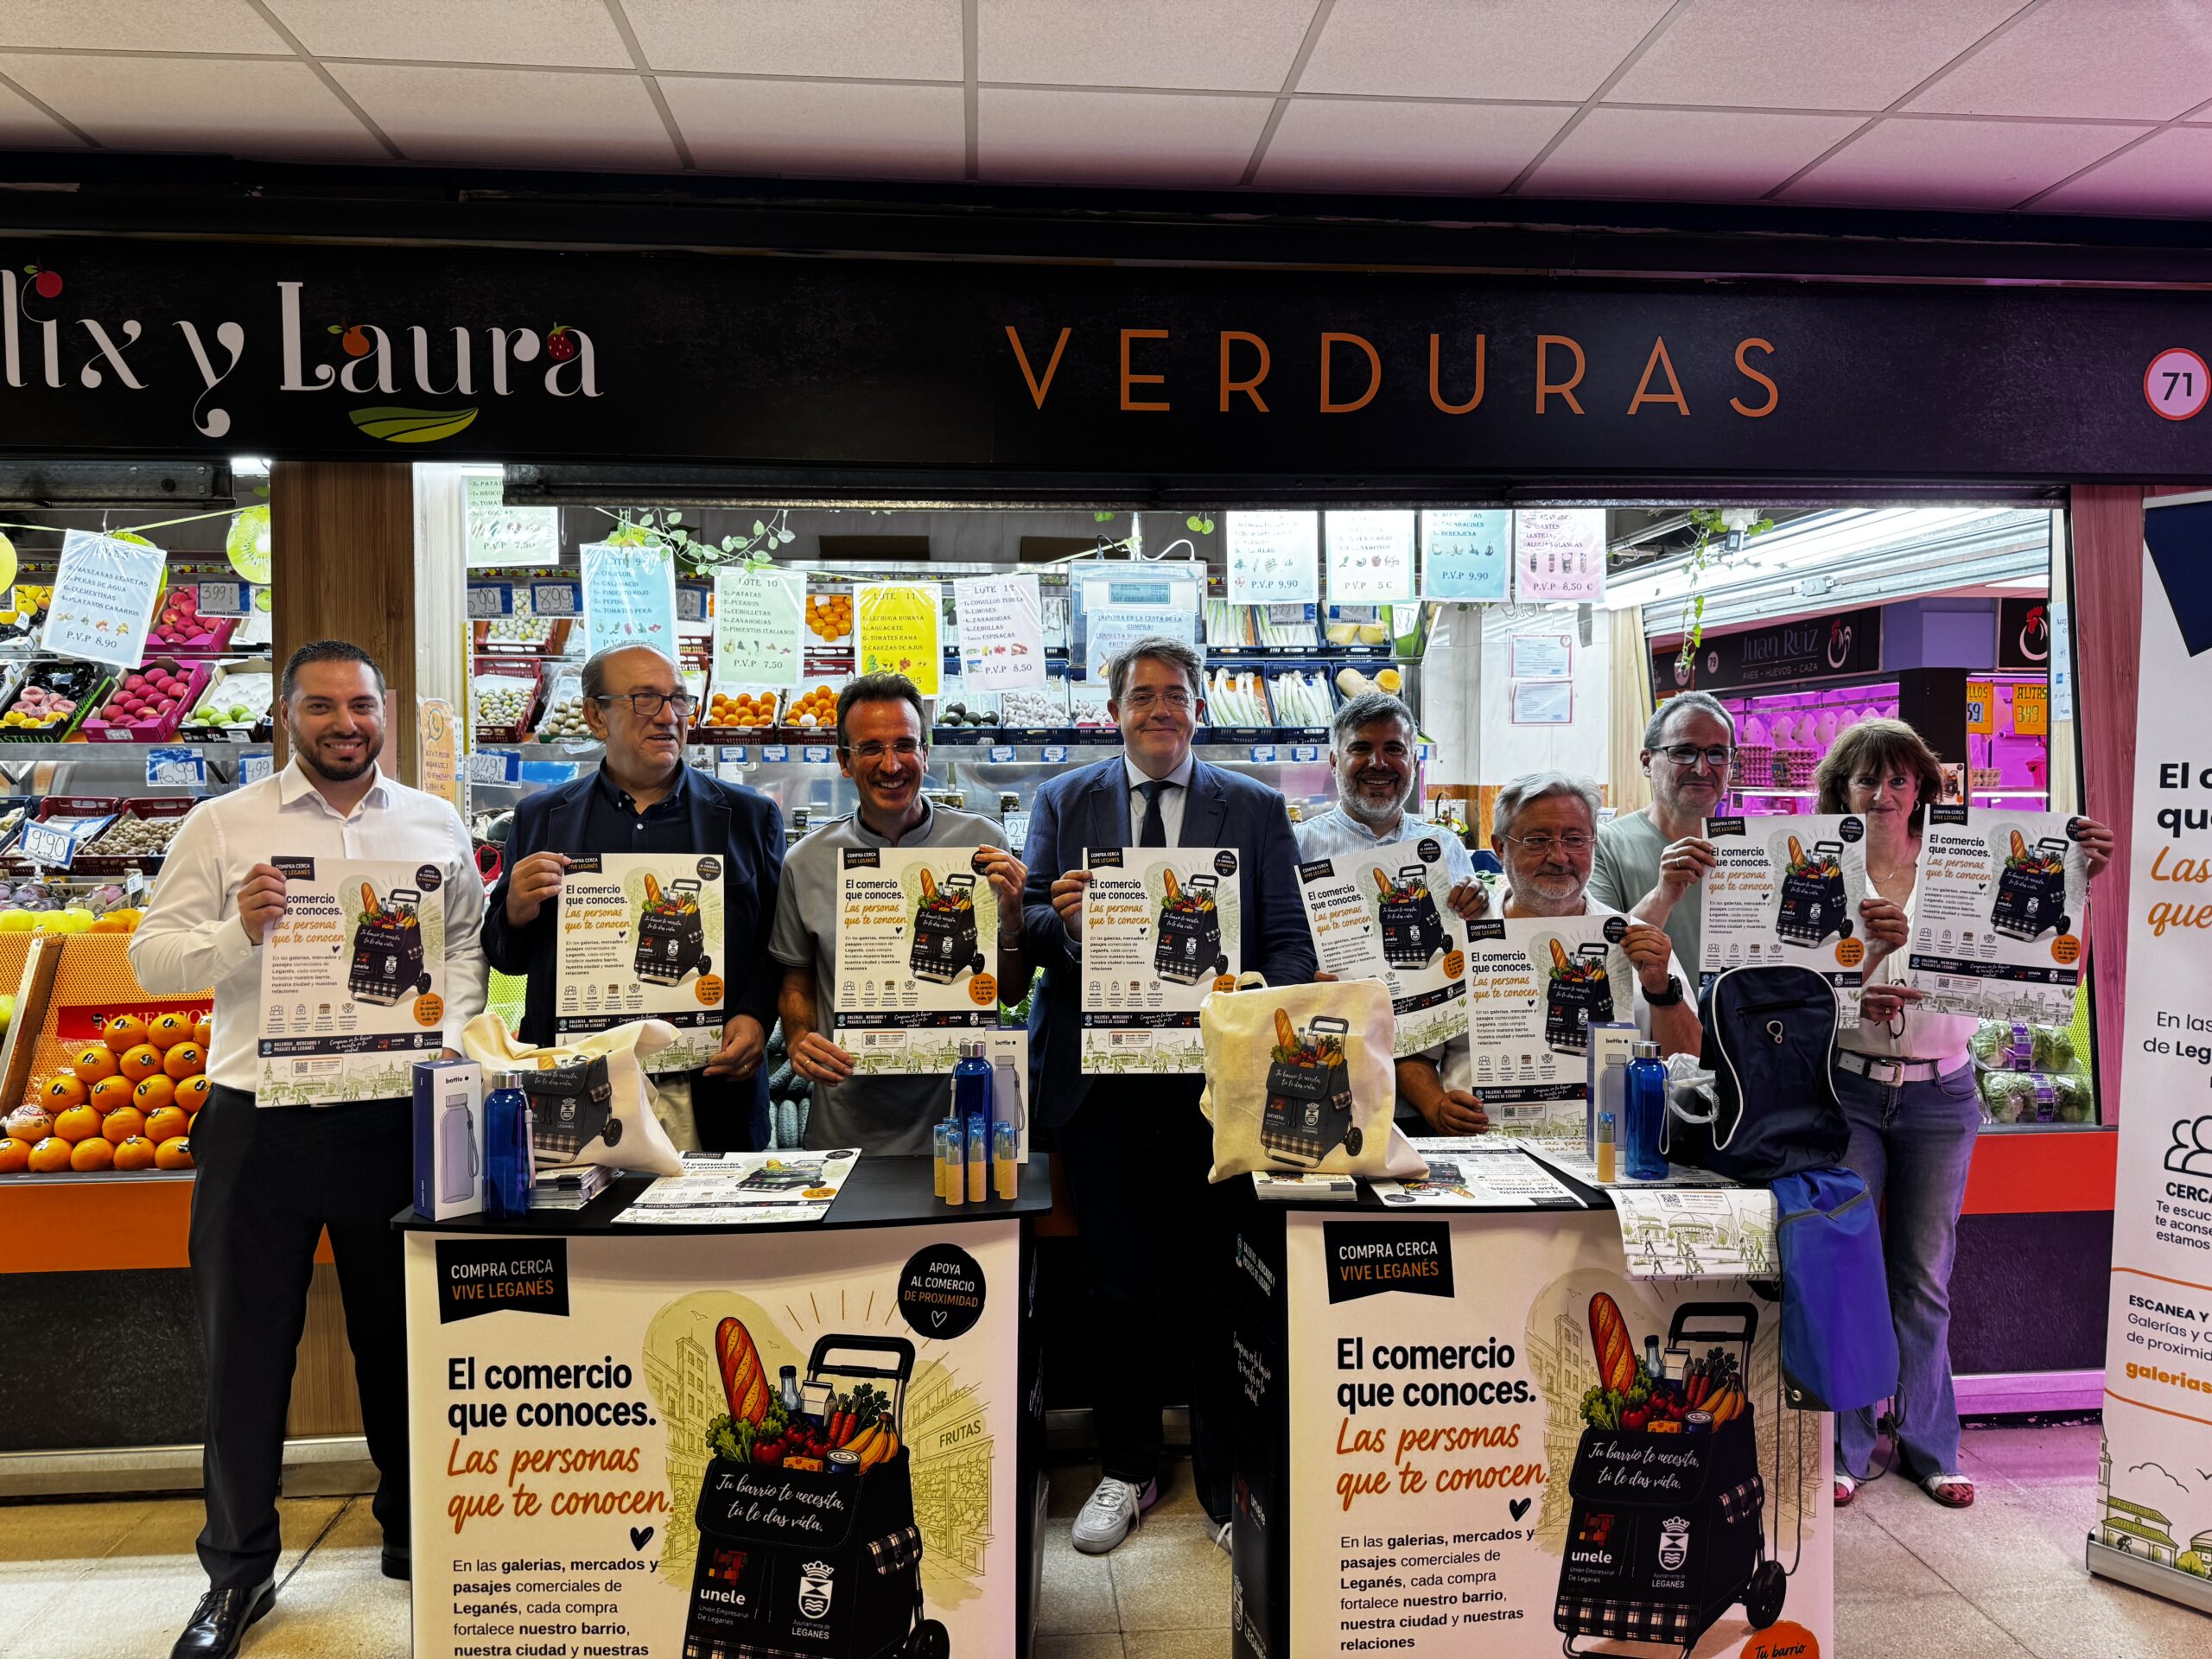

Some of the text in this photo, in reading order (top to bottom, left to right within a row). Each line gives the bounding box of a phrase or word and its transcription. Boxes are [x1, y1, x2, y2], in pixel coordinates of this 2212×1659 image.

[173, 321, 245, 438] y
[277, 281, 604, 397] Laura
[1004, 327, 1781, 418] VERDURAS
[2160, 371, 2193, 399] 71
[739, 578, 760, 587] LOTE
[1251, 580, 1274, 588] P.V.P
[67, 631, 91, 642] P.V.P
[1742, 624, 1818, 661] Juan Ruiz
[985, 665, 1007, 674] P.V.P
[1743, 663, 1818, 680] AVES HUEVOS CAZA
[2160, 762, 2189, 788] El
[2158, 809, 2212, 837] qu
[1929, 834, 1985, 846] El comercio
[1929, 846, 1991, 857] que conoces.
[2151, 846, 2212, 883] Las
[846, 879, 898, 889] El comercio
[846, 890, 904, 902] que conoces.
[2148, 902, 2212, 937] que
[2158, 1011, 2212, 1032] En las
[2144, 1037, 2211, 1065] de Leg
[445, 1076, 463, 1084] bottle
[2157, 1200, 2211, 1221] Te escuc
[2156, 1215, 2166, 1226] te
[2157, 1231, 2210, 1249] estamos
[1339, 1241, 1438, 1260] COMPRA CERCA
[451, 1259, 553, 1279] COMPRA CERCA
[929, 1262, 961, 1275] APOYA
[1340, 1259, 1439, 1281] VIVE LEGANÉS
[452, 1277, 554, 1300] VIVE LEGANÉS
[911, 1276, 975, 1292] AL COMERCIO
[904, 1290, 978, 1307] DE PROXIMIDAD
[2129, 1294, 2209, 1323] ESCANEA Y
[2128, 1313, 2199, 1343] Galerías y
[2126, 1332, 2144, 1344] de
[1338, 1336, 1515, 1370] El comercio
[448, 1355, 632, 1389] El comercio
[1337, 1379, 1536, 1414] que conoces.
[448, 1401, 657, 1435] que conoces.
[939, 1420, 981, 1448] FRUTAS
[1336, 1417, 1521, 1466] Las personas
[448, 1438, 640, 1487] Las personas
[1588, 1440, 1700, 1468] Tu barrio te necesita,
[1336, 1461, 1550, 1512] que te conocen.
[1598, 1466, 1681, 1490] tú le das vida.
[716, 1473, 844, 1511] Tu barrio te necesita,
[448, 1483, 675, 1535] que te conocen.
[728, 1500, 823, 1532] tú le das vida.
[454, 1558, 658, 1573] En las galerias, mercados y
[1572, 1550, 1612, 1564] unele
[454, 1580, 622, 1596] pasajes comerciales de
[1651, 1579, 1685, 1589] LEGANÉS
[700, 1588, 746, 1605] unele
[454, 1601, 618, 1617] Leganés, cada compra
[716, 1607, 749, 1618] Empresarial
[708, 1615, 734, 1625] Leganés
[792, 1619, 823, 1629] Ayuntamiento
[454, 1623, 630, 1637] fortalece nuestro barrio,
[791, 1627, 830, 1639] LEGANÉS
[454, 1643, 649, 1658] nuestra ciudad y nuestras
[1755, 1643, 1807, 1659] Tu barrio
